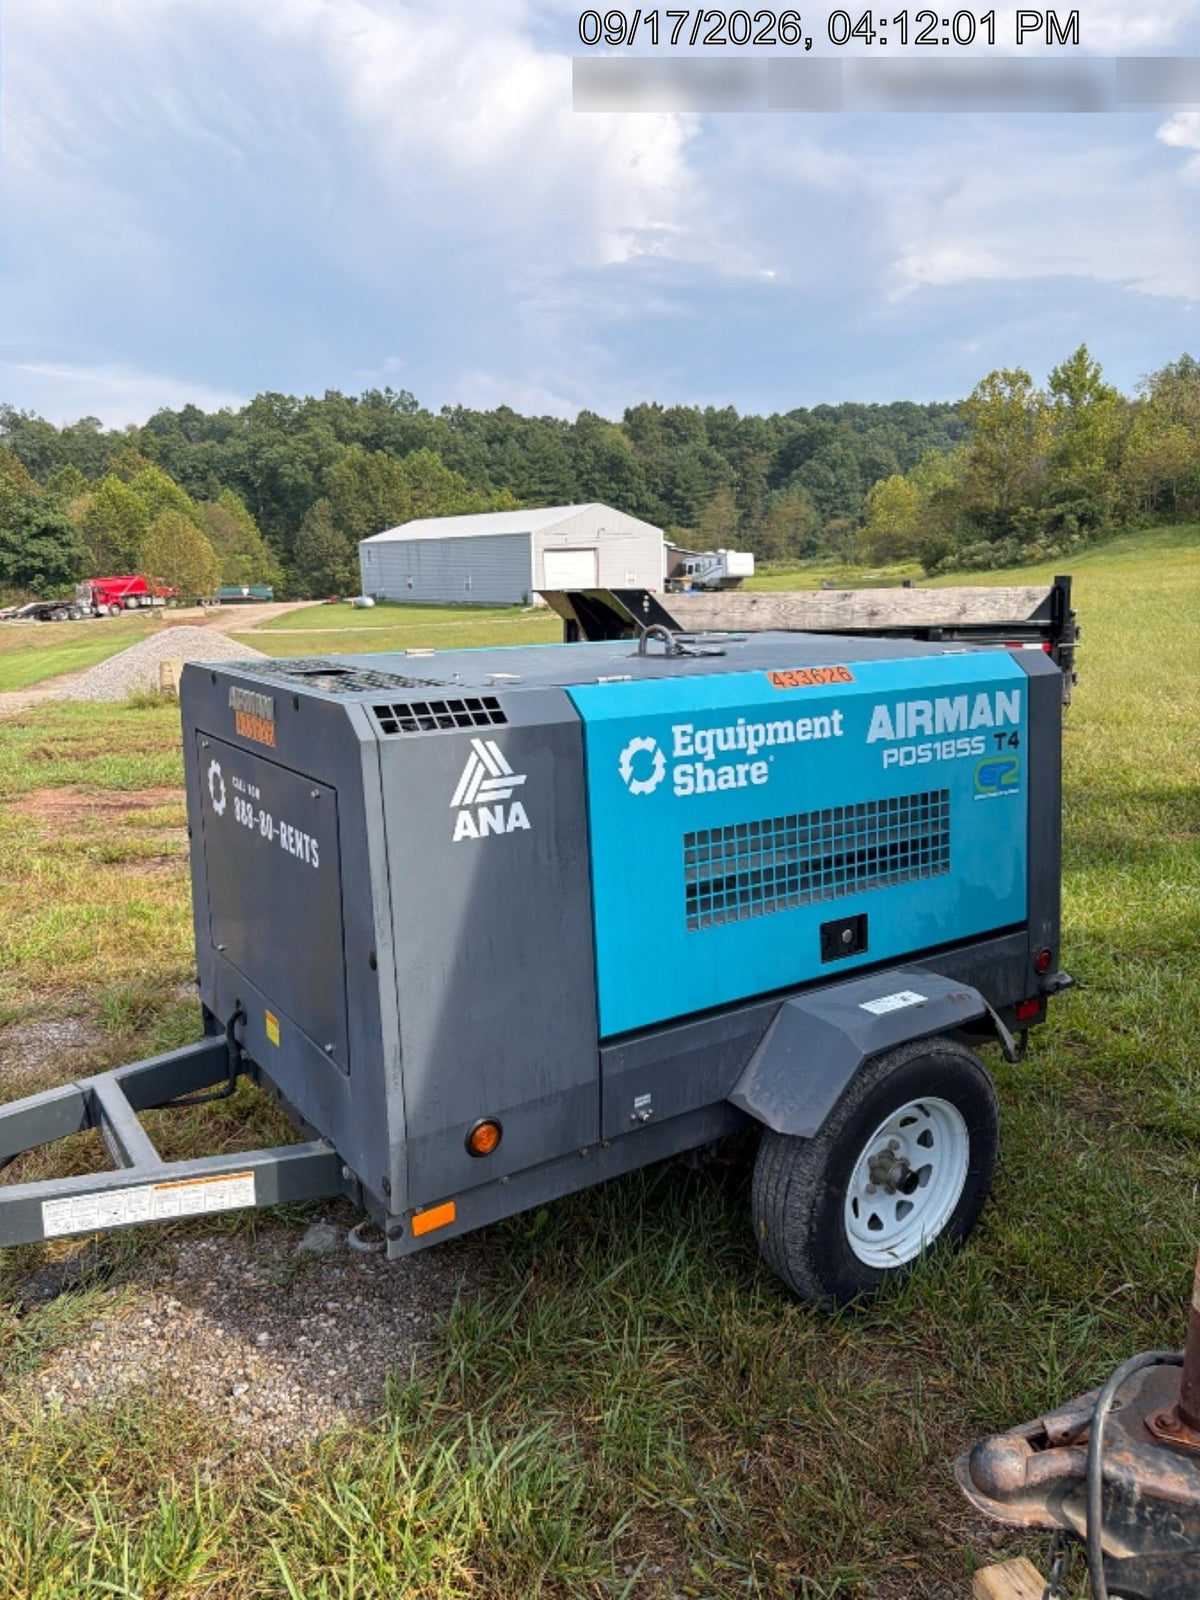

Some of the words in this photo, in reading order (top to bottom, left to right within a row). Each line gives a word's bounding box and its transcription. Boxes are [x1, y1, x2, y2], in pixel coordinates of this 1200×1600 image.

[772, 666, 853, 688] 433626
[672, 709, 844, 761] Equipment
[866, 690, 1021, 743] AIRMAN
[883, 736, 986, 769] PDS185S
[993, 730, 1020, 751] T4
[673, 761, 769, 797] Share
[233, 796, 319, 868] 888-80-RENTS
[453, 801, 532, 842] ANA
